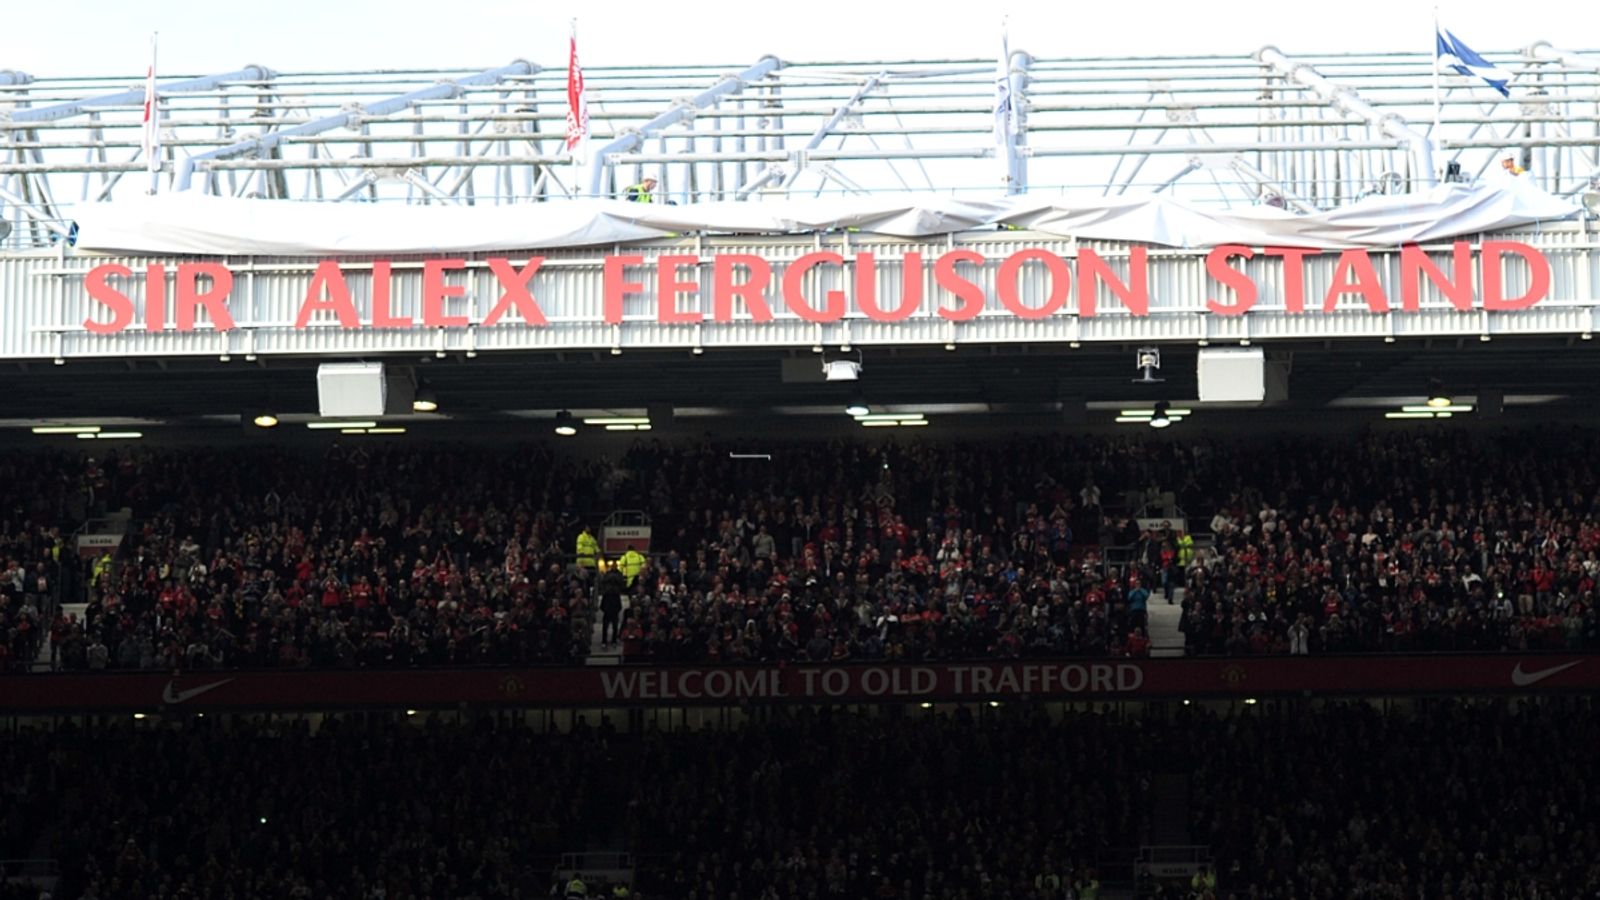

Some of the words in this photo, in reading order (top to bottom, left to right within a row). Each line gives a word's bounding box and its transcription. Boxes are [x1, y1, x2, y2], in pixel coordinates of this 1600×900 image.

[83, 262, 235, 333] SIR
[295, 256, 549, 329] ALEX
[603, 246, 1149, 323] FERGUSON
[1205, 240, 1551, 316] STAND
[798, 668, 849, 696] TO
[861, 667, 938, 696] OLD
[948, 664, 1144, 694] TRAFFORD
